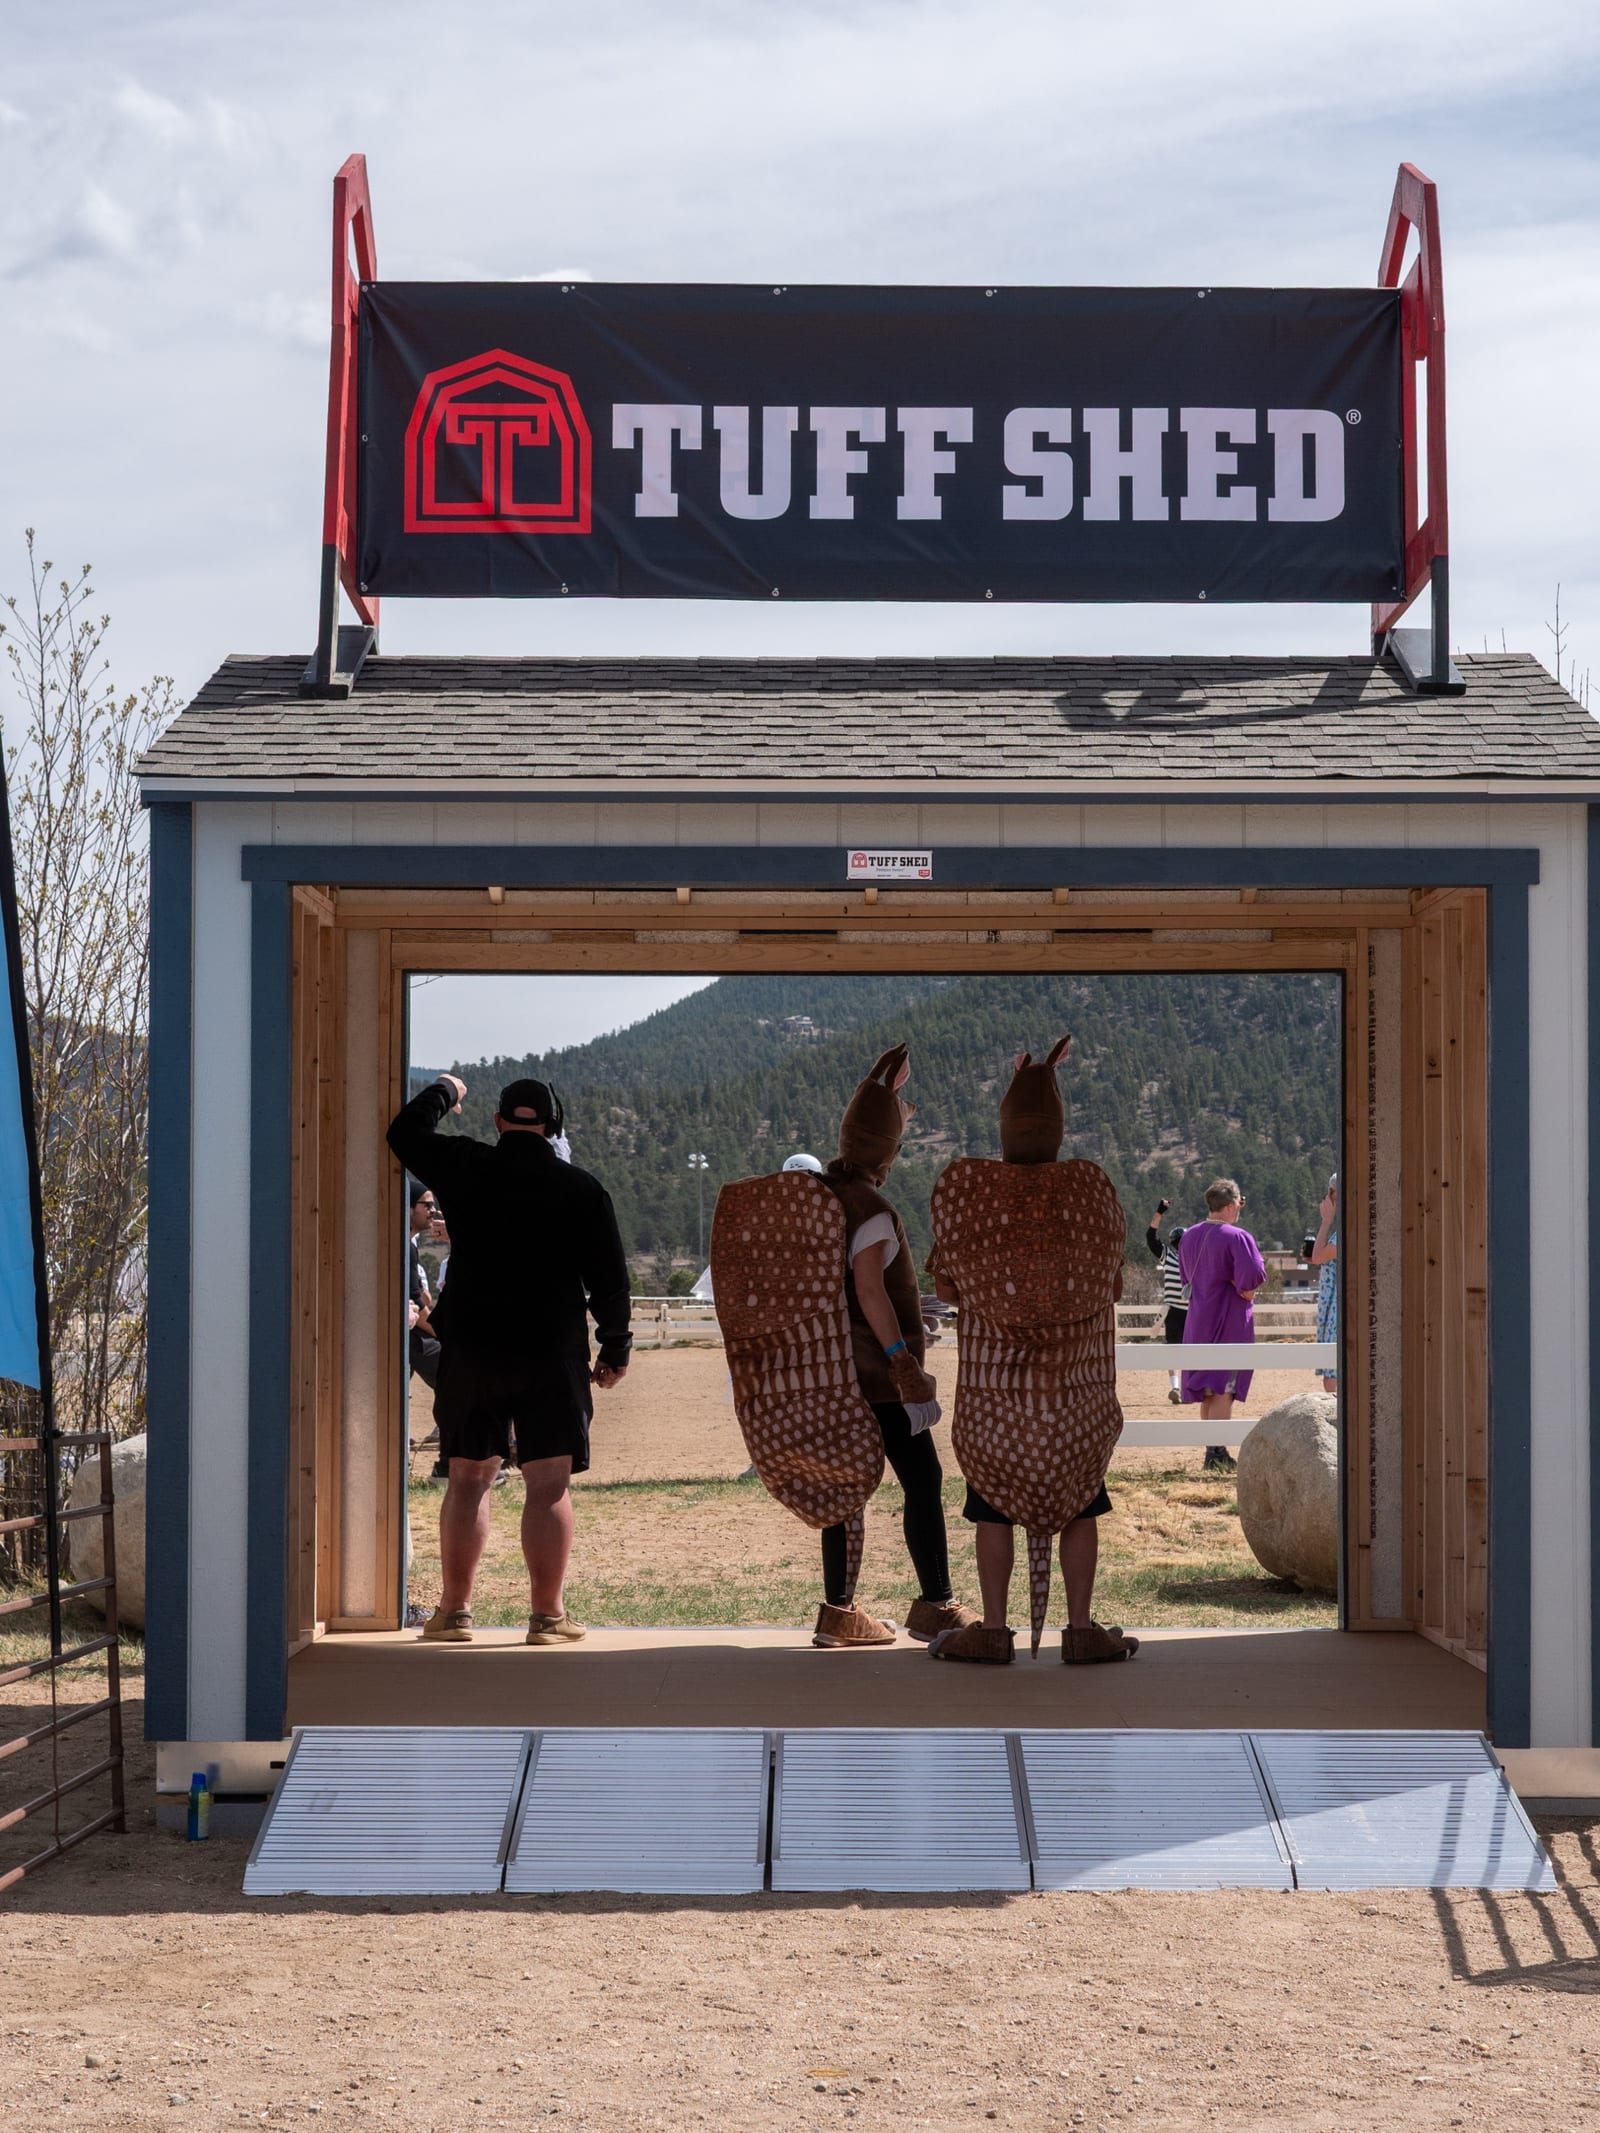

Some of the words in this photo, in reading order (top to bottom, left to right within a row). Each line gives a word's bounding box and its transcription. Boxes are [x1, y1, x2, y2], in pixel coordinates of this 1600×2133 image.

[612, 403, 974, 521] TUFF
[868, 856, 898, 867] TUFF
[899, 856, 928, 867] SHED
